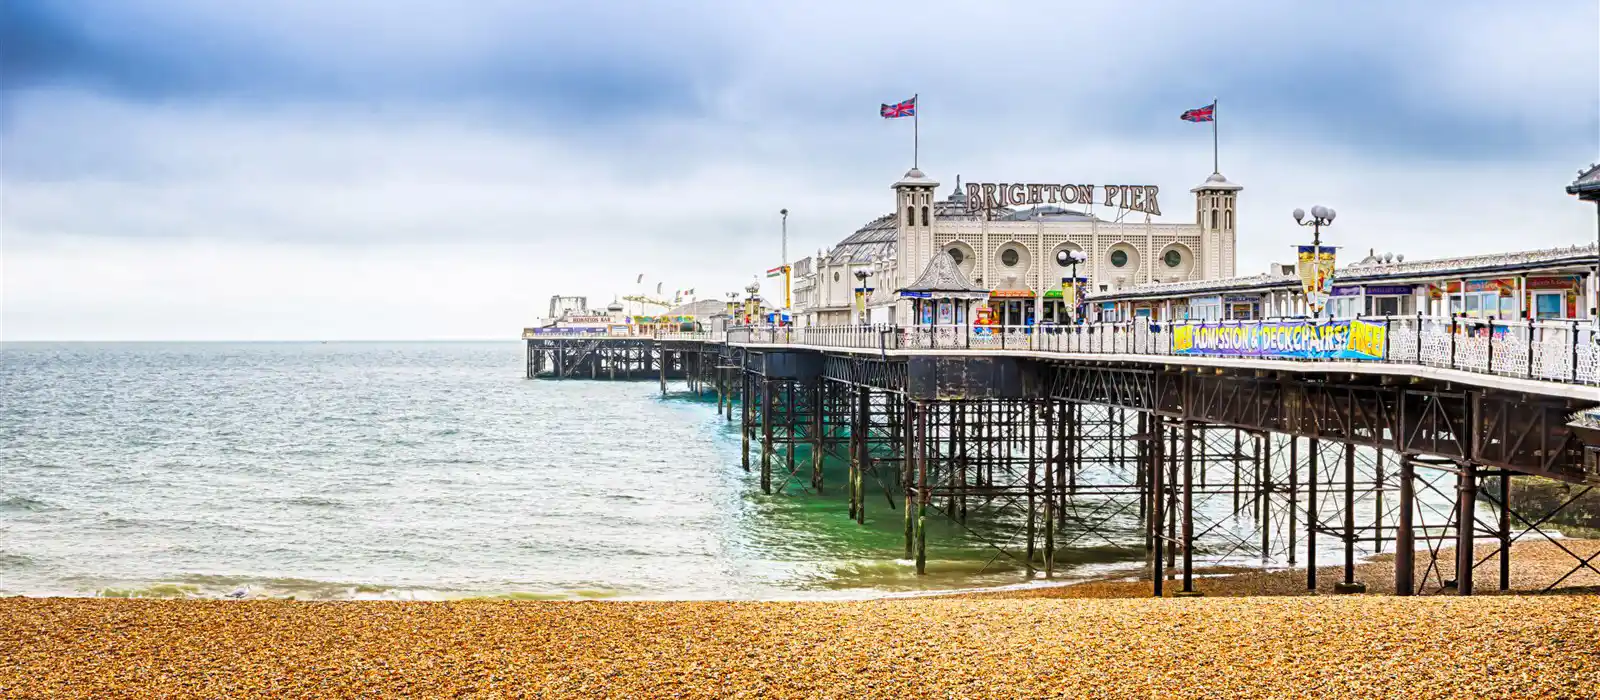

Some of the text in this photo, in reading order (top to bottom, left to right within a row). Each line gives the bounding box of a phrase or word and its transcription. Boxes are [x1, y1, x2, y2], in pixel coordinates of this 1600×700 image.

[965, 182, 1162, 216] BRIGHTON PIER
[1194, 326, 1250, 350] ADMISSION
[1251, 328, 1259, 349] &
